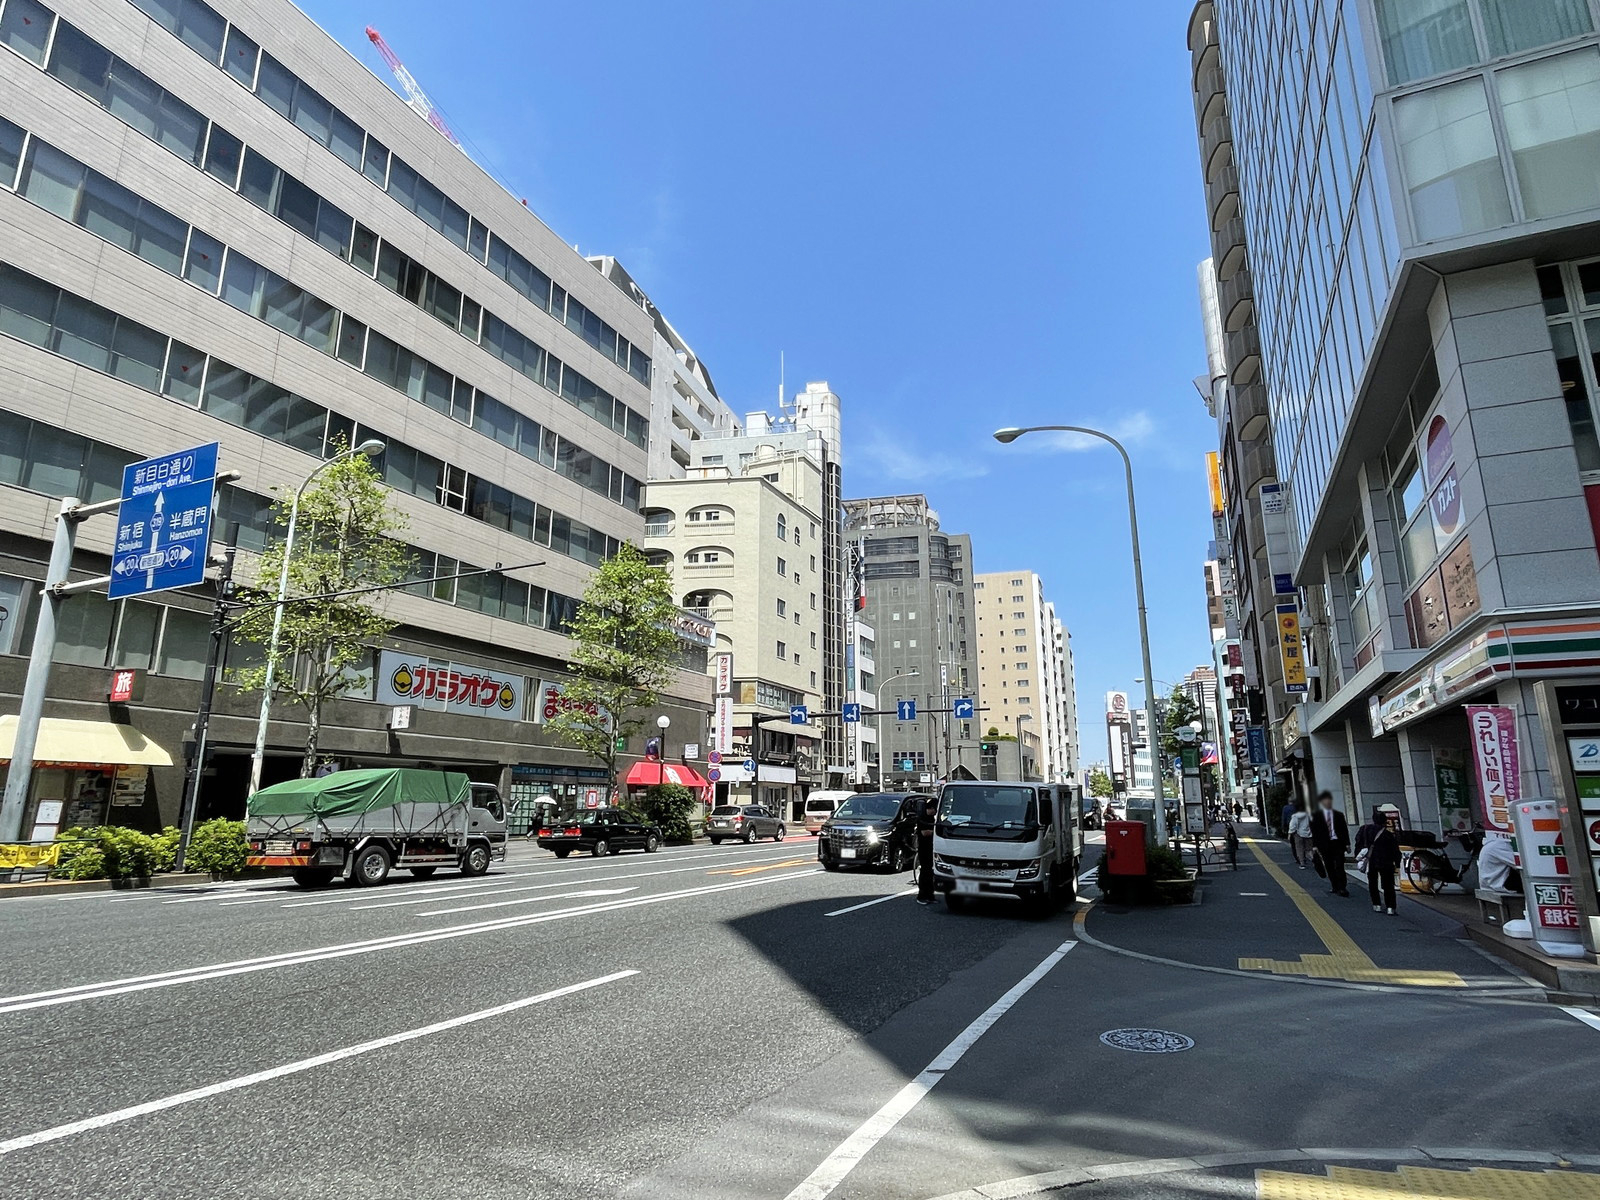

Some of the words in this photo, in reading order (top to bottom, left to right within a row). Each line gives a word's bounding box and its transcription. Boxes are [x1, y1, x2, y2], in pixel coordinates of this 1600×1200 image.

[134, 455, 193, 485] 新目白通り
[178, 473, 192, 485] Ave.
[1437, 476, 1457, 516] ガスト
[169, 506, 207, 530] 半蔵門
[118, 521, 145, 541] 新宿
[169, 527, 203, 541] Hanzomon
[117, 540, 143, 553] Shinjuku
[169, 549, 179, 560] 20
[125, 558, 135, 569] 20
[1284, 633, 1298, 658] 松屋
[115, 671, 132, 693] 旅
[719, 656, 727, 691] カラオケ
[412, 666, 501, 706] カラオケ
[1536, 886, 1560, 905] 酒
[1544, 908, 1580, 926] 銀行
